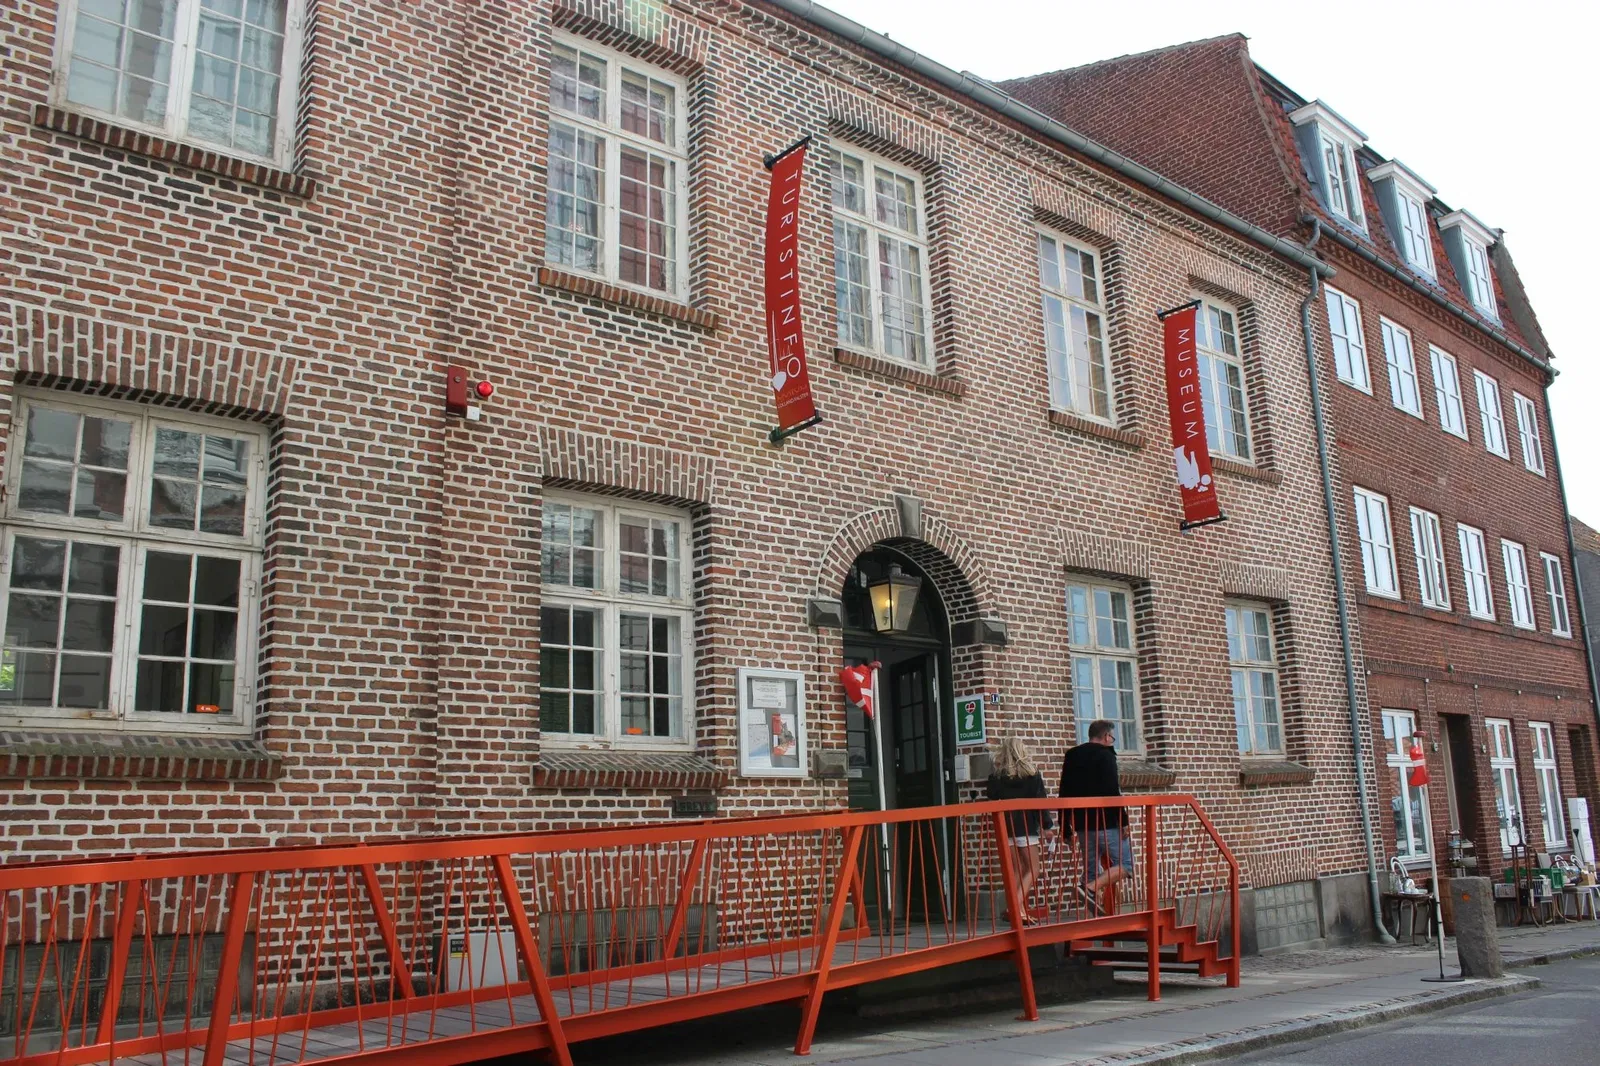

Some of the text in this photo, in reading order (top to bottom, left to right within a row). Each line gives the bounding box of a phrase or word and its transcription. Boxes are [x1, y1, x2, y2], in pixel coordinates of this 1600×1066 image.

[779, 169, 801, 378] TURISTINFO
[1178, 328, 1199, 439] MUSEUM
[960, 731, 981, 739] TOURIST
